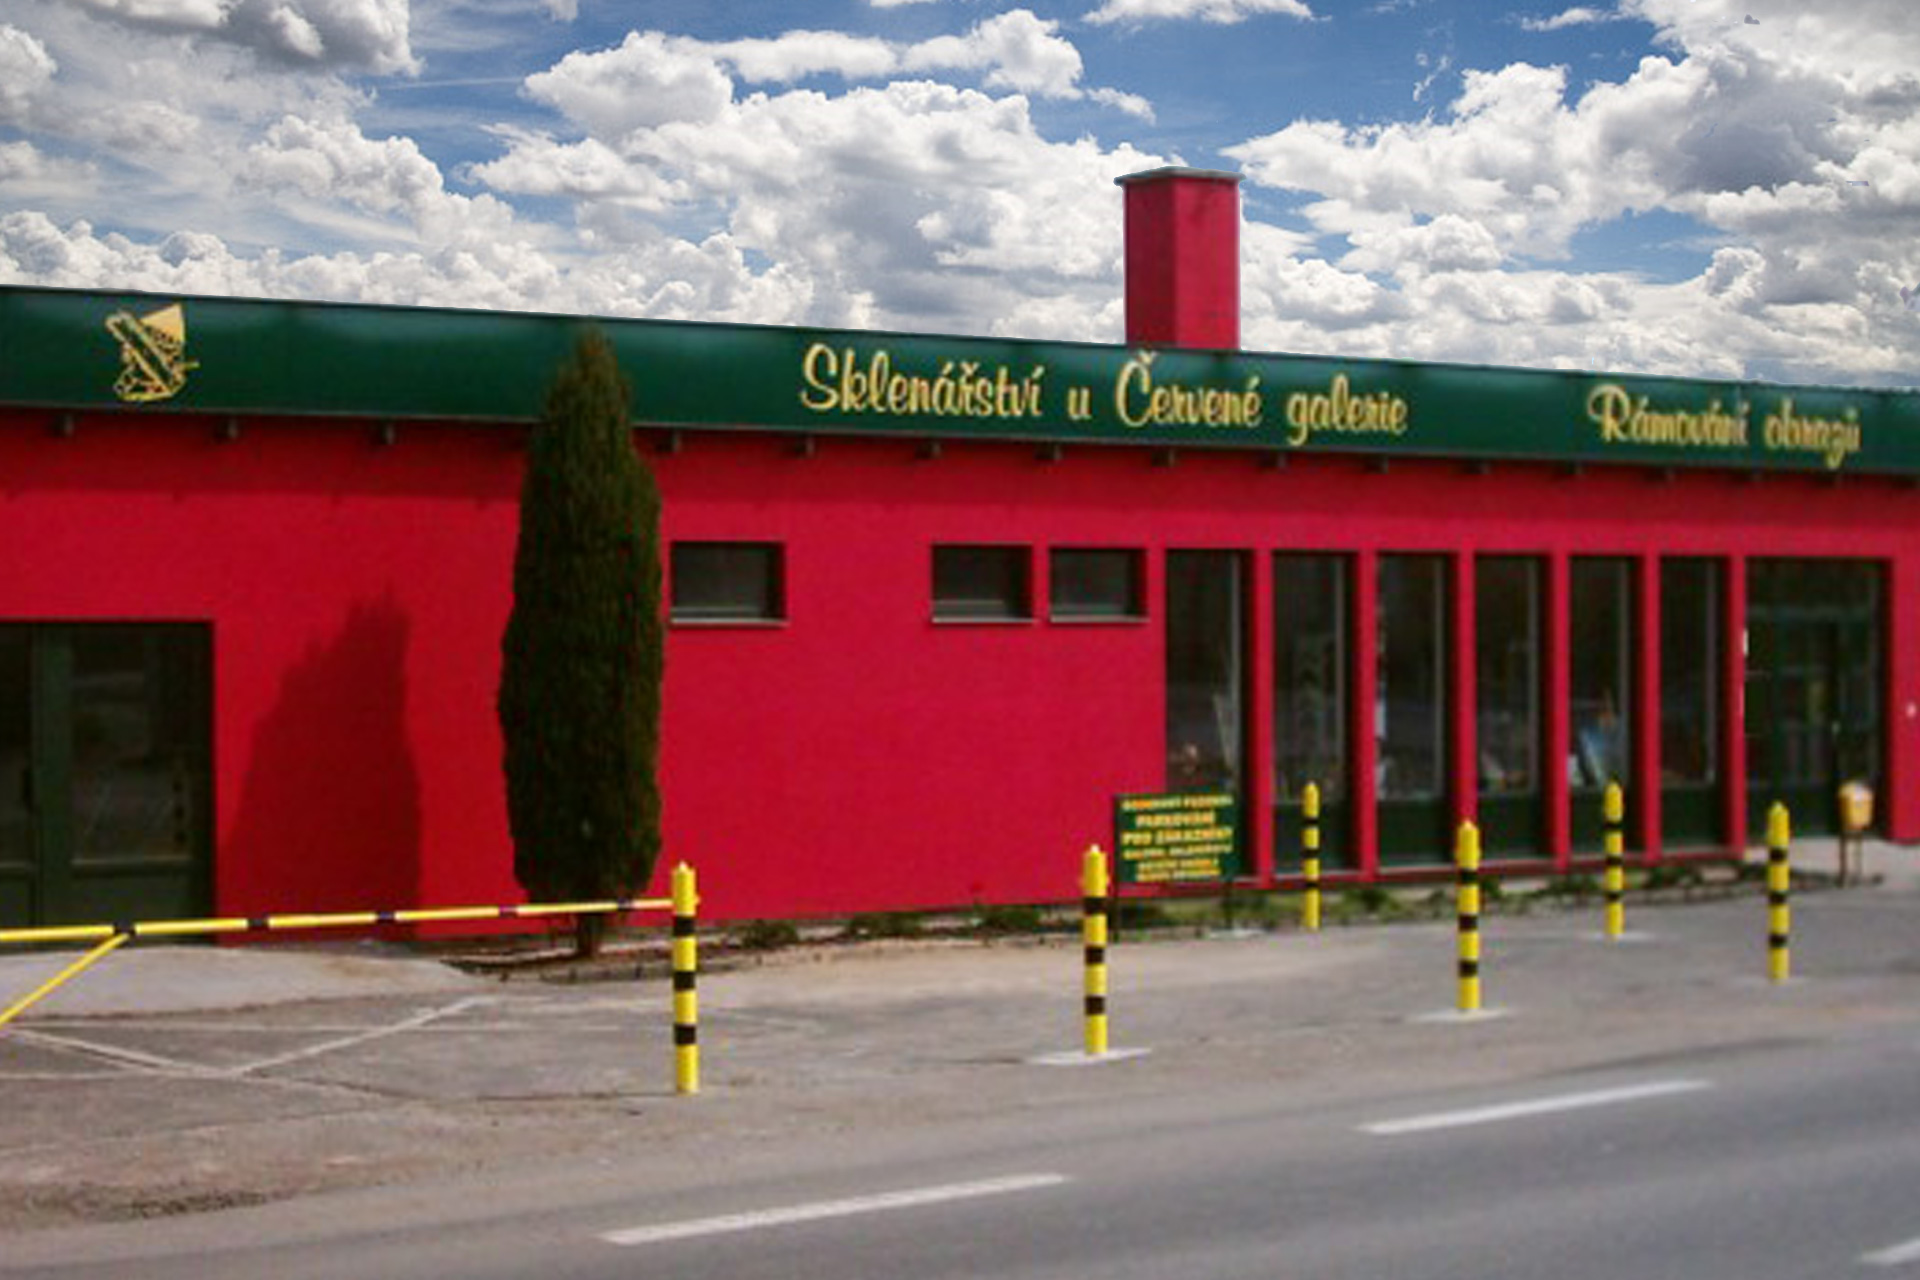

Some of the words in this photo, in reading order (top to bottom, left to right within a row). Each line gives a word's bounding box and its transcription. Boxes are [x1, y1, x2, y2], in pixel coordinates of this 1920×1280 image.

[800, 342, 1046, 419] Sklenářství
[1067, 385, 1092, 421] u
[1115, 350, 1264, 429] Červené
[1285, 373, 1409, 446] galerie
